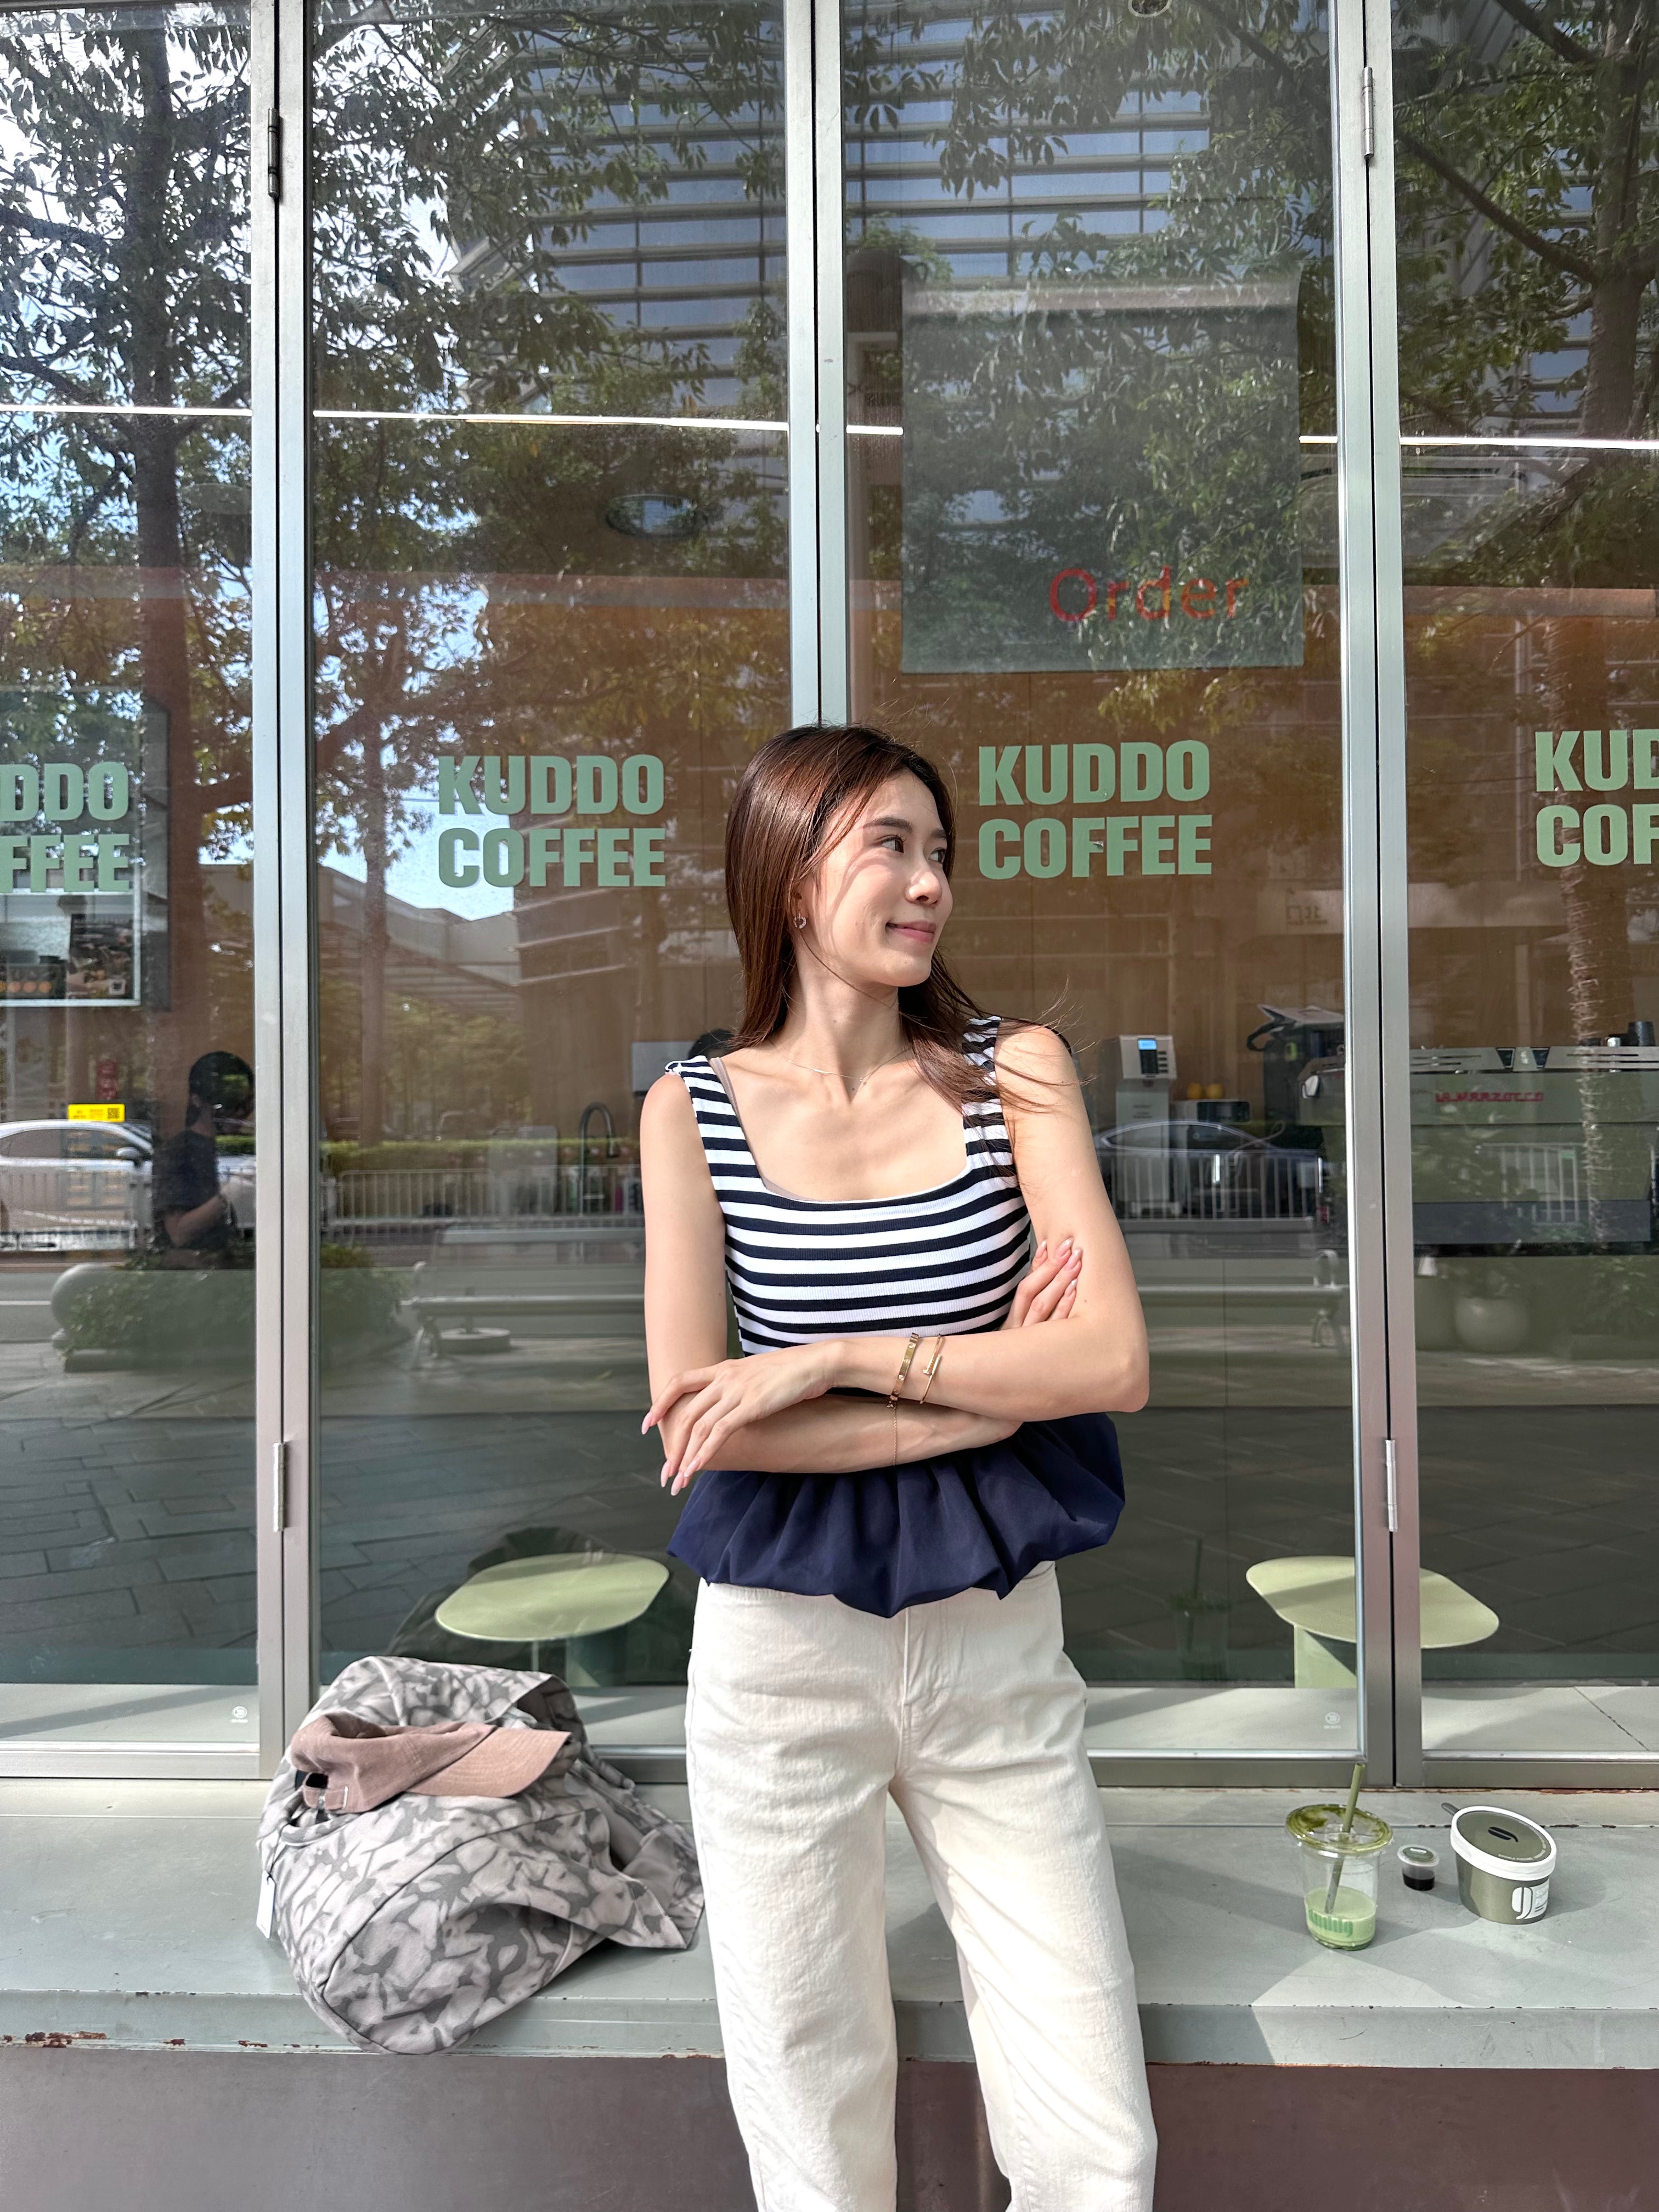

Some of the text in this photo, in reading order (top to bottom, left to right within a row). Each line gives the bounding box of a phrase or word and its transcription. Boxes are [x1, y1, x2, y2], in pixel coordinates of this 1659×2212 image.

[1049, 565, 1249, 622] Order
[0, 761, 128, 821] DDO
[438, 754, 664, 815] KUDDO
[979, 740, 1210, 806] KUDDO
[1535, 729, 1659, 792] KUD
[0, 833, 130, 893] FFEE
[438, 828, 665, 888] COFFEE
[979, 815, 1212, 879] COFFEE
[1536, 803, 1659, 867] COF
